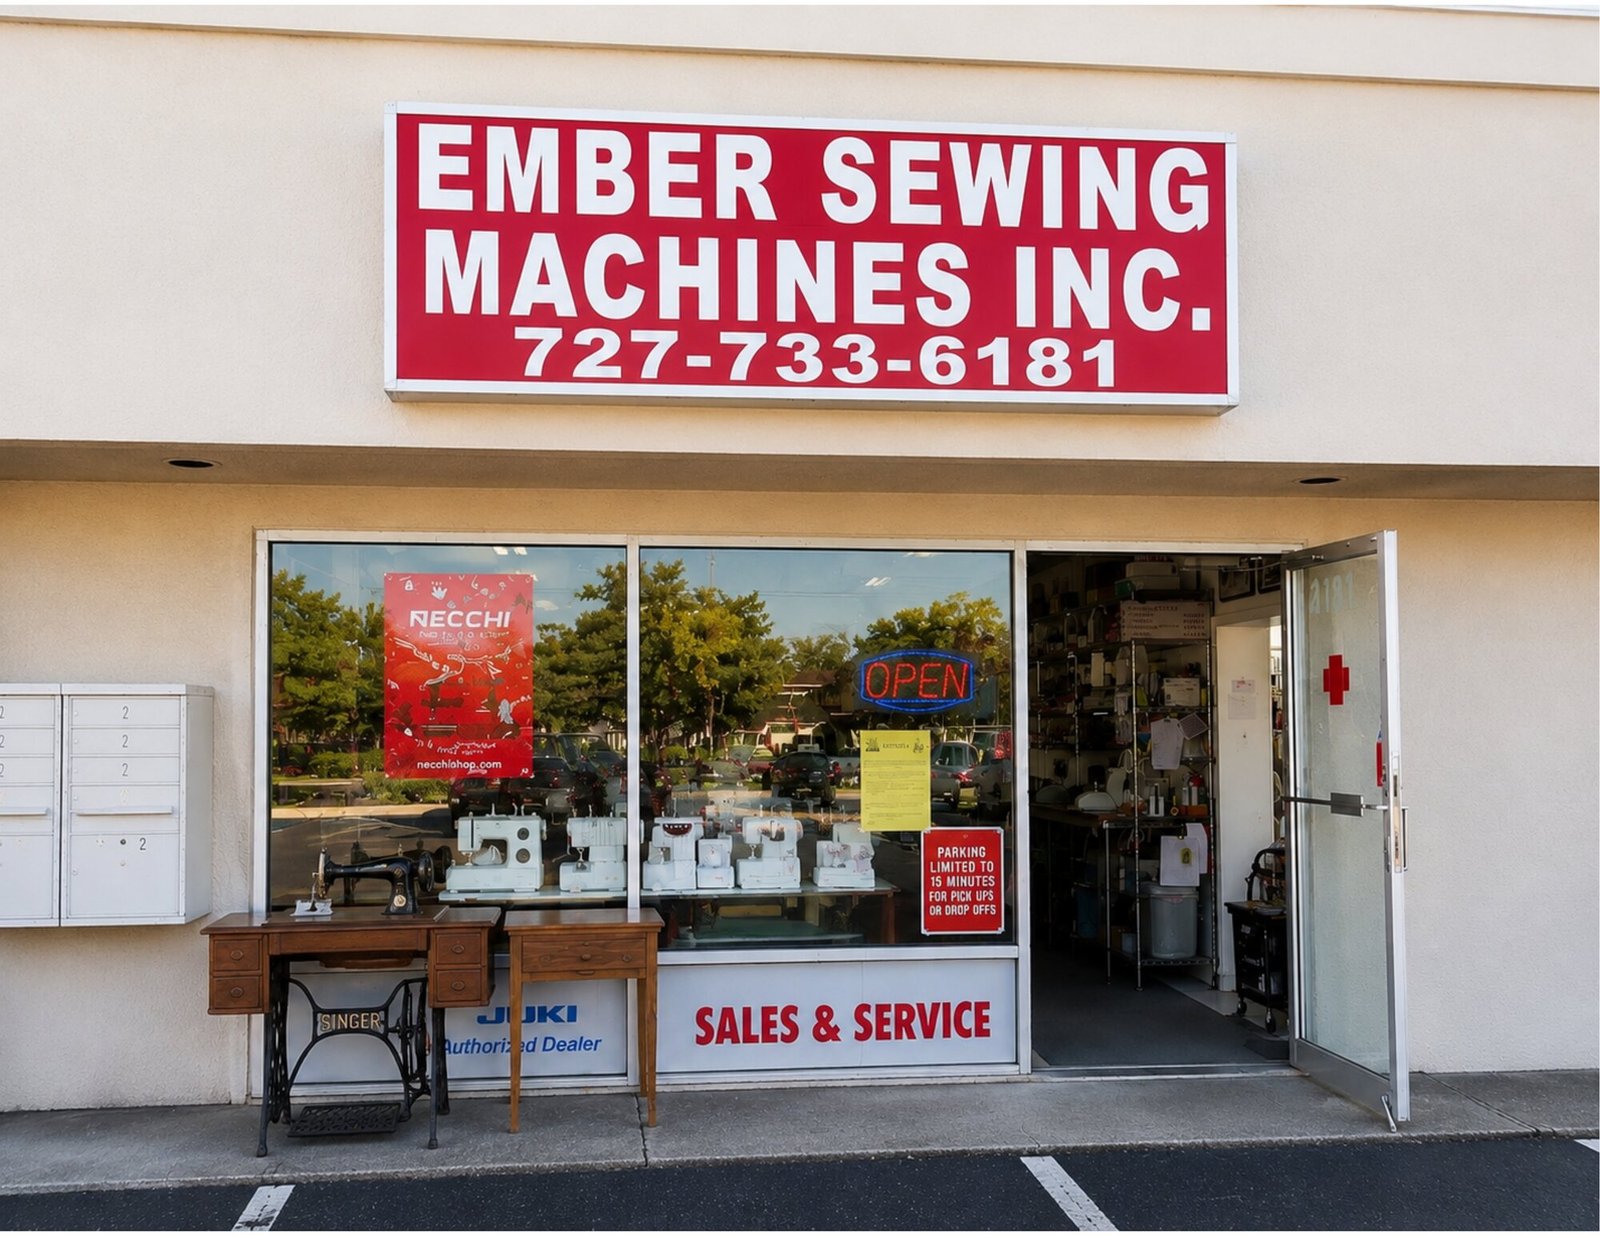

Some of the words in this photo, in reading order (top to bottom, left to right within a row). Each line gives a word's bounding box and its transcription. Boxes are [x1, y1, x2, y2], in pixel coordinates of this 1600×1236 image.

[418, 123, 777, 221] EMBER
[821, 136, 1210, 234] SEWING
[425, 228, 971, 327] MACHINES
[1015, 246, 1212, 332] INC.
[514, 326, 1116, 389] 727-733-6181
[409, 610, 511, 628] NECCHI
[865, 662, 969, 699] OPEN
[122, 705, 129, 720] 2
[122, 734, 129, 749] 2
[122, 762, 129, 777] 2
[139, 837, 147, 851] 2
[937, 846, 986, 859] PARKING
[930, 861, 975, 873] LIMITED
[980, 860, 994, 872] TO
[930, 875, 942, 887] 15
[946, 875, 995, 887] MINUTES
[929, 890, 947, 902] FOR
[950, 890, 972, 902] PICK
[976, 889, 994, 901] UPS
[929, 905, 942, 916] OR
[945, 904, 970, 916] DROP
[972, 904, 996, 915] OFFS
[320, 1012, 380, 1031] SINGER
[477, 1005, 577, 1024] JUKI
[695, 1005, 800, 1046] SALES
[811, 1004, 841, 1043] &
[853, 1001, 991, 1042] SERVICE
[542, 1036, 602, 1052] Dealer
